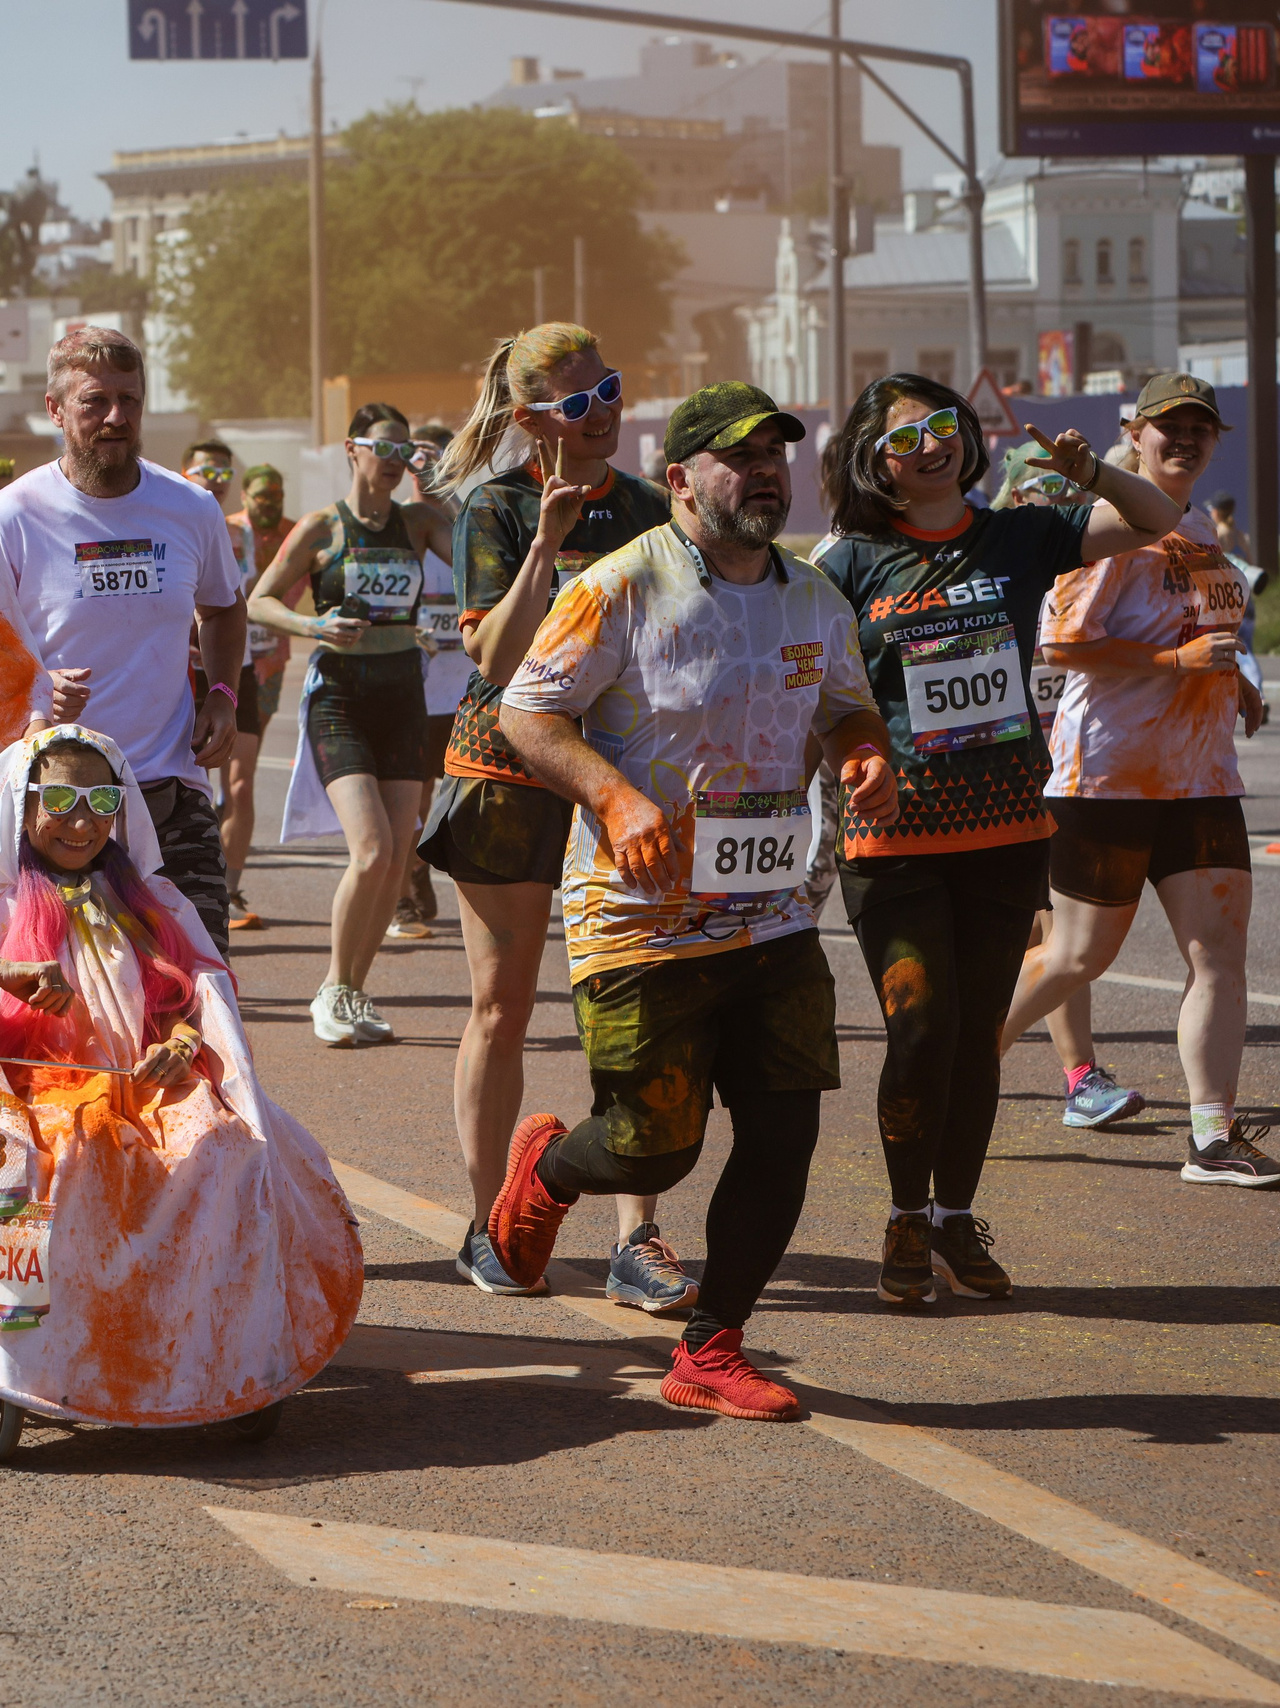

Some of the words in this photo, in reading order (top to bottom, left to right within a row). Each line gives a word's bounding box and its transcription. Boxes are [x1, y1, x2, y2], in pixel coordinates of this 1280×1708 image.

[92, 569, 148, 591] 5870
[357, 573, 411, 596] 2622
[869, 576, 1011, 623] #ЗАБЕГ
[1207, 581, 1244, 611] 6083
[883, 617, 960, 644] БЕГОВОЙ
[963, 611, 1008, 633] КЛУБ
[786, 643, 823, 660] БОЛЬШЕ
[912, 631, 1009, 658] КРАСОЧНЫЙ
[973, 640, 1016, 657] 2026
[797, 657, 815, 672] ЧЕМ
[786, 670, 822, 689] МОЖЕШЬ
[924, 668, 1008, 714] 5009
[709, 792, 801, 810] КРАСОЧНЫЙ
[770, 806, 810, 819] 2026
[715, 834, 795, 875] 8184
[1075, 1095, 1094, 1109] HOKA
